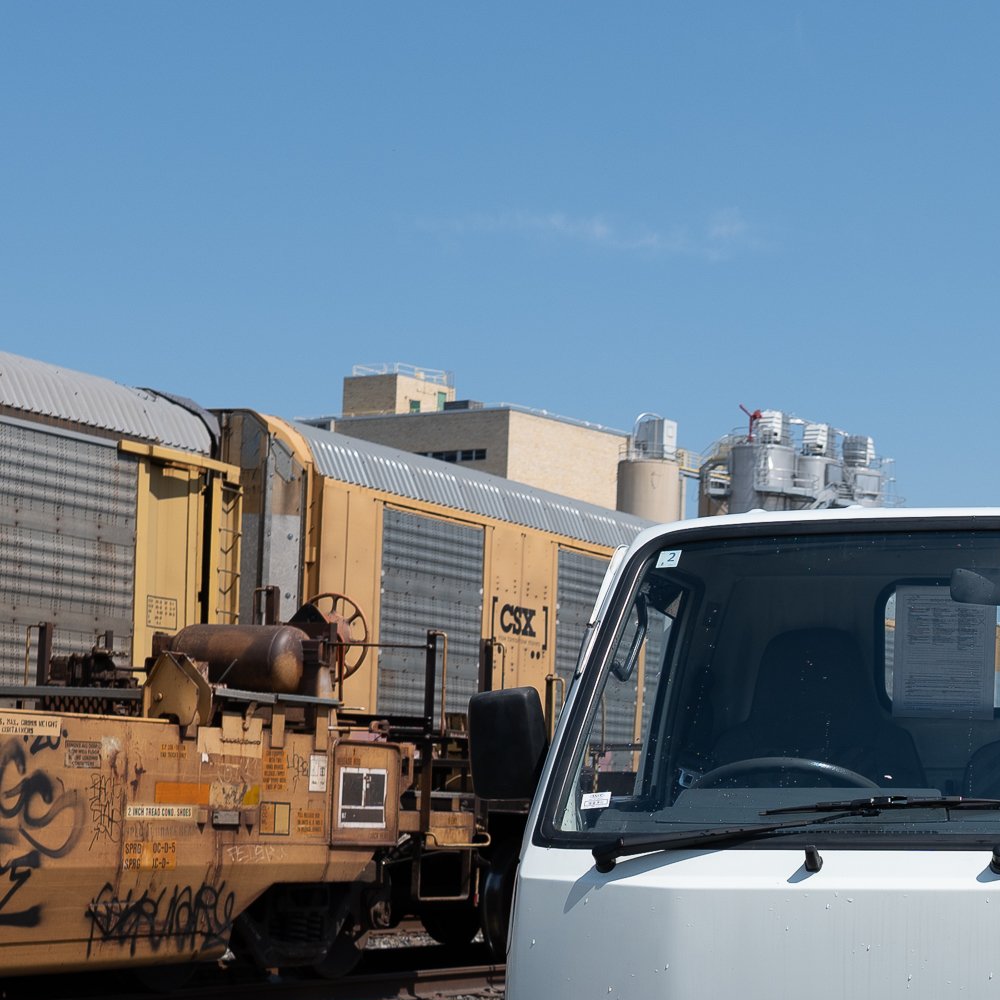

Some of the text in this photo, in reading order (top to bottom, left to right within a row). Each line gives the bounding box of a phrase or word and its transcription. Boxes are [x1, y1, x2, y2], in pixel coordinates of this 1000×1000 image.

[667, 552, 676, 562] 2
[500, 603, 536, 638] CSX
[127, 807, 192, 816] 2 INCH TREAD COND. SHOES
